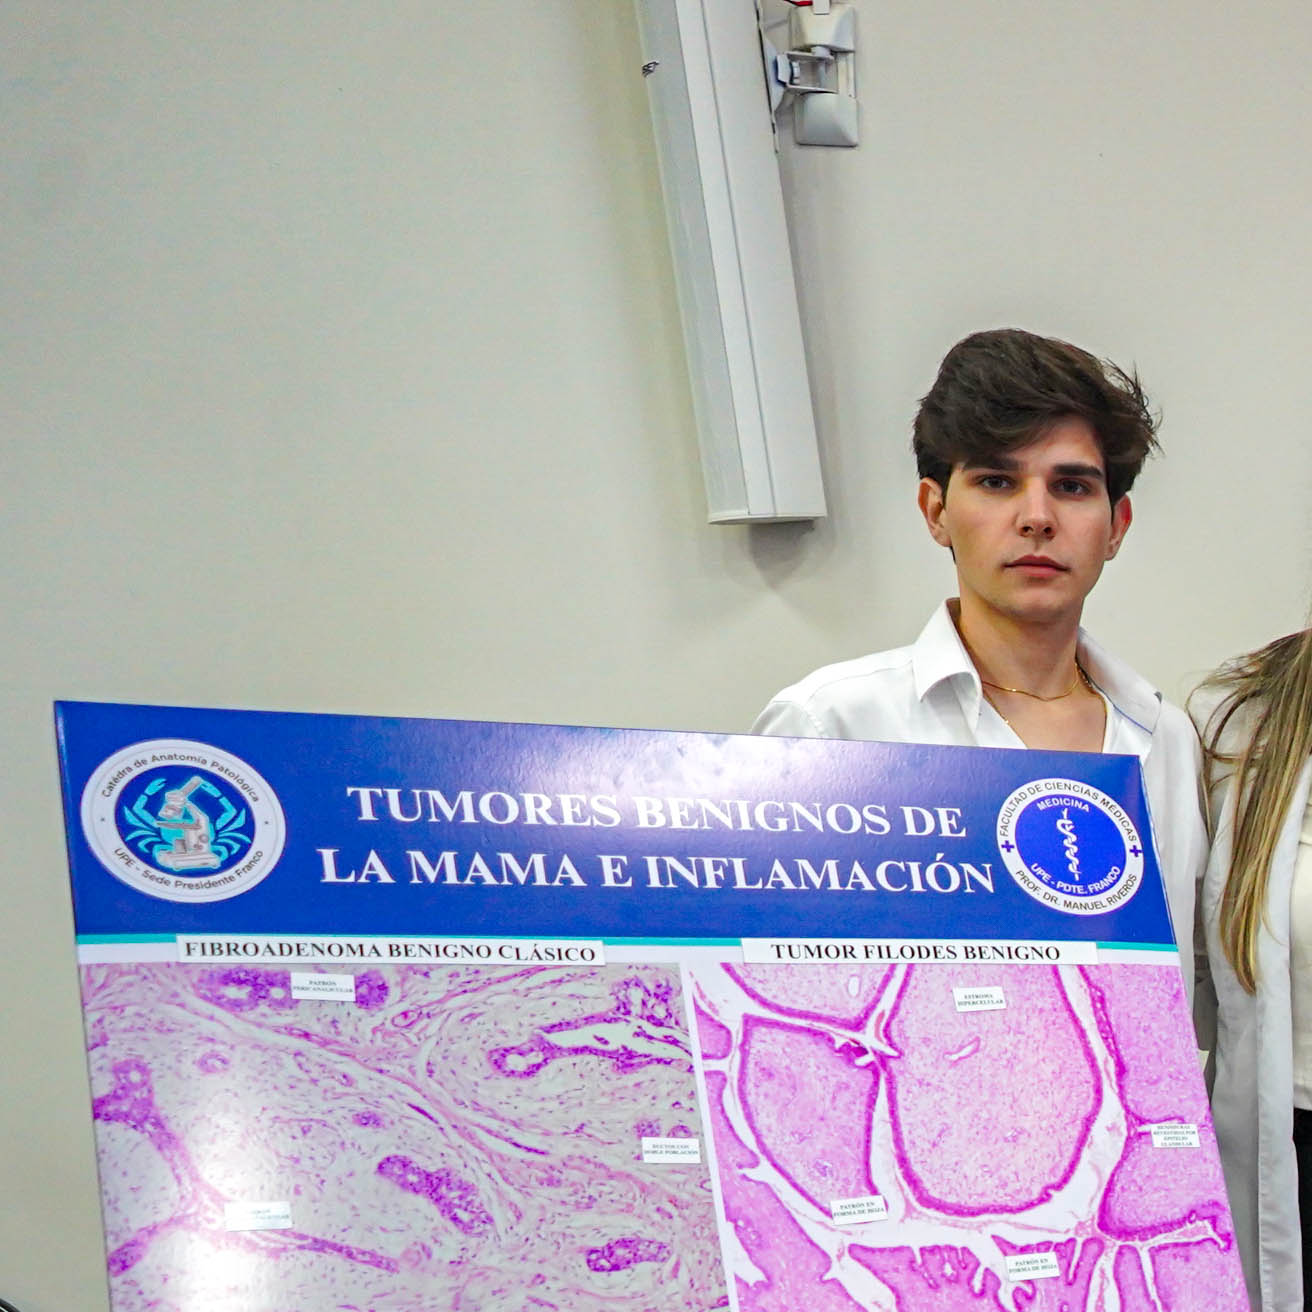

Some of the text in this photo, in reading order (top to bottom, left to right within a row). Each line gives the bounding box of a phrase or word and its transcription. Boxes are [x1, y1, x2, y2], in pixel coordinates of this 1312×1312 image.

[347, 786, 967, 838] TUMORES BENIGNOS DE
[1000, 782, 1137, 842] FACULTAD DE CIENCIAS MÉDICAS
[1037, 798, 1089, 812] MEDICINA
[113, 846, 264, 891] UPE Sede Presidente Franco
[316, 849, 996, 894] LA MAMA E INFLAMACIÓN
[1031, 863, 1121, 895] UPE PDTE. FRANCO
[1016, 870, 1137, 911] PROF. DR. MANUEL RIVEROS
[186, 942, 595, 961] FIBROADENOMA BENIGNO CLÁSICO
[770, 944, 1061, 961] TUMOR FILODES BENIGNO
